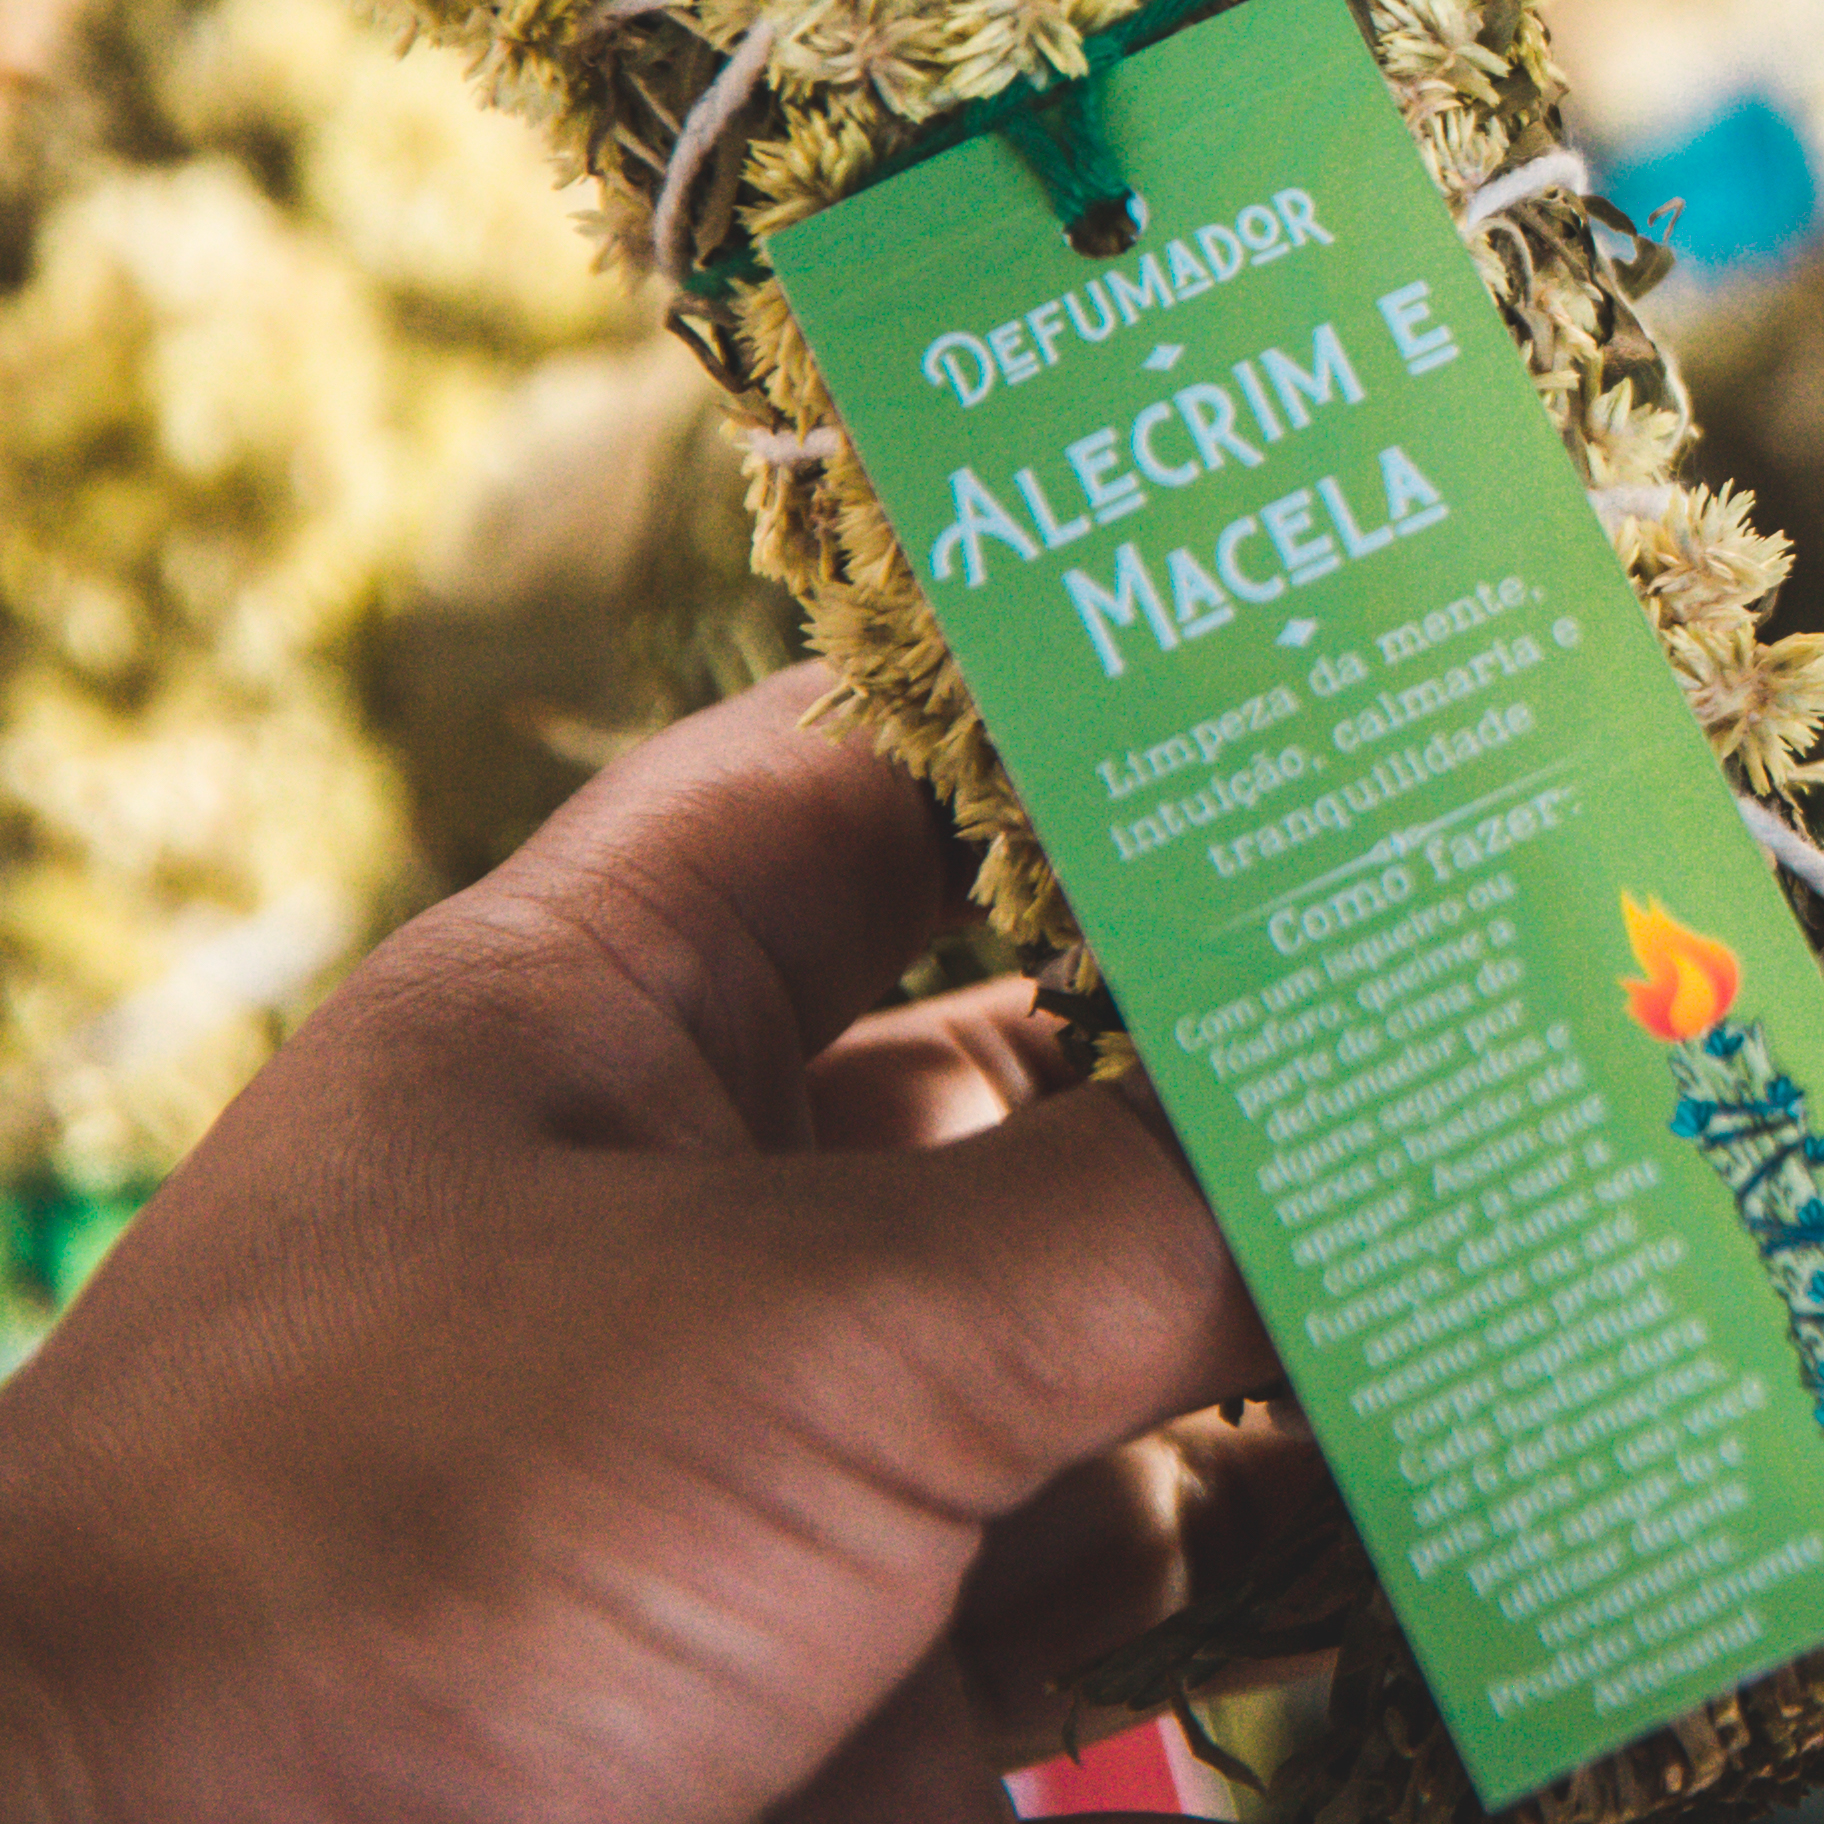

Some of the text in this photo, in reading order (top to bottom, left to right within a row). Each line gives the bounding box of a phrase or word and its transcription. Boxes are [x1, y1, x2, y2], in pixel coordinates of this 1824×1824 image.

[921, 186, 1336, 409] DEFUMADOR
[927, 279, 1461, 590] ALECRIM E
[1062, 445, 1448, 677] MACELA
[1095, 685, 1301, 799] Limpeza
[1308, 649, 1370, 697] da
[1333, 635, 1543, 752] calmaria
[1552, 613, 1584, 648] e
[1209, 703, 1533, 876] tranquilidade
[1268, 847, 1415, 955] Como
